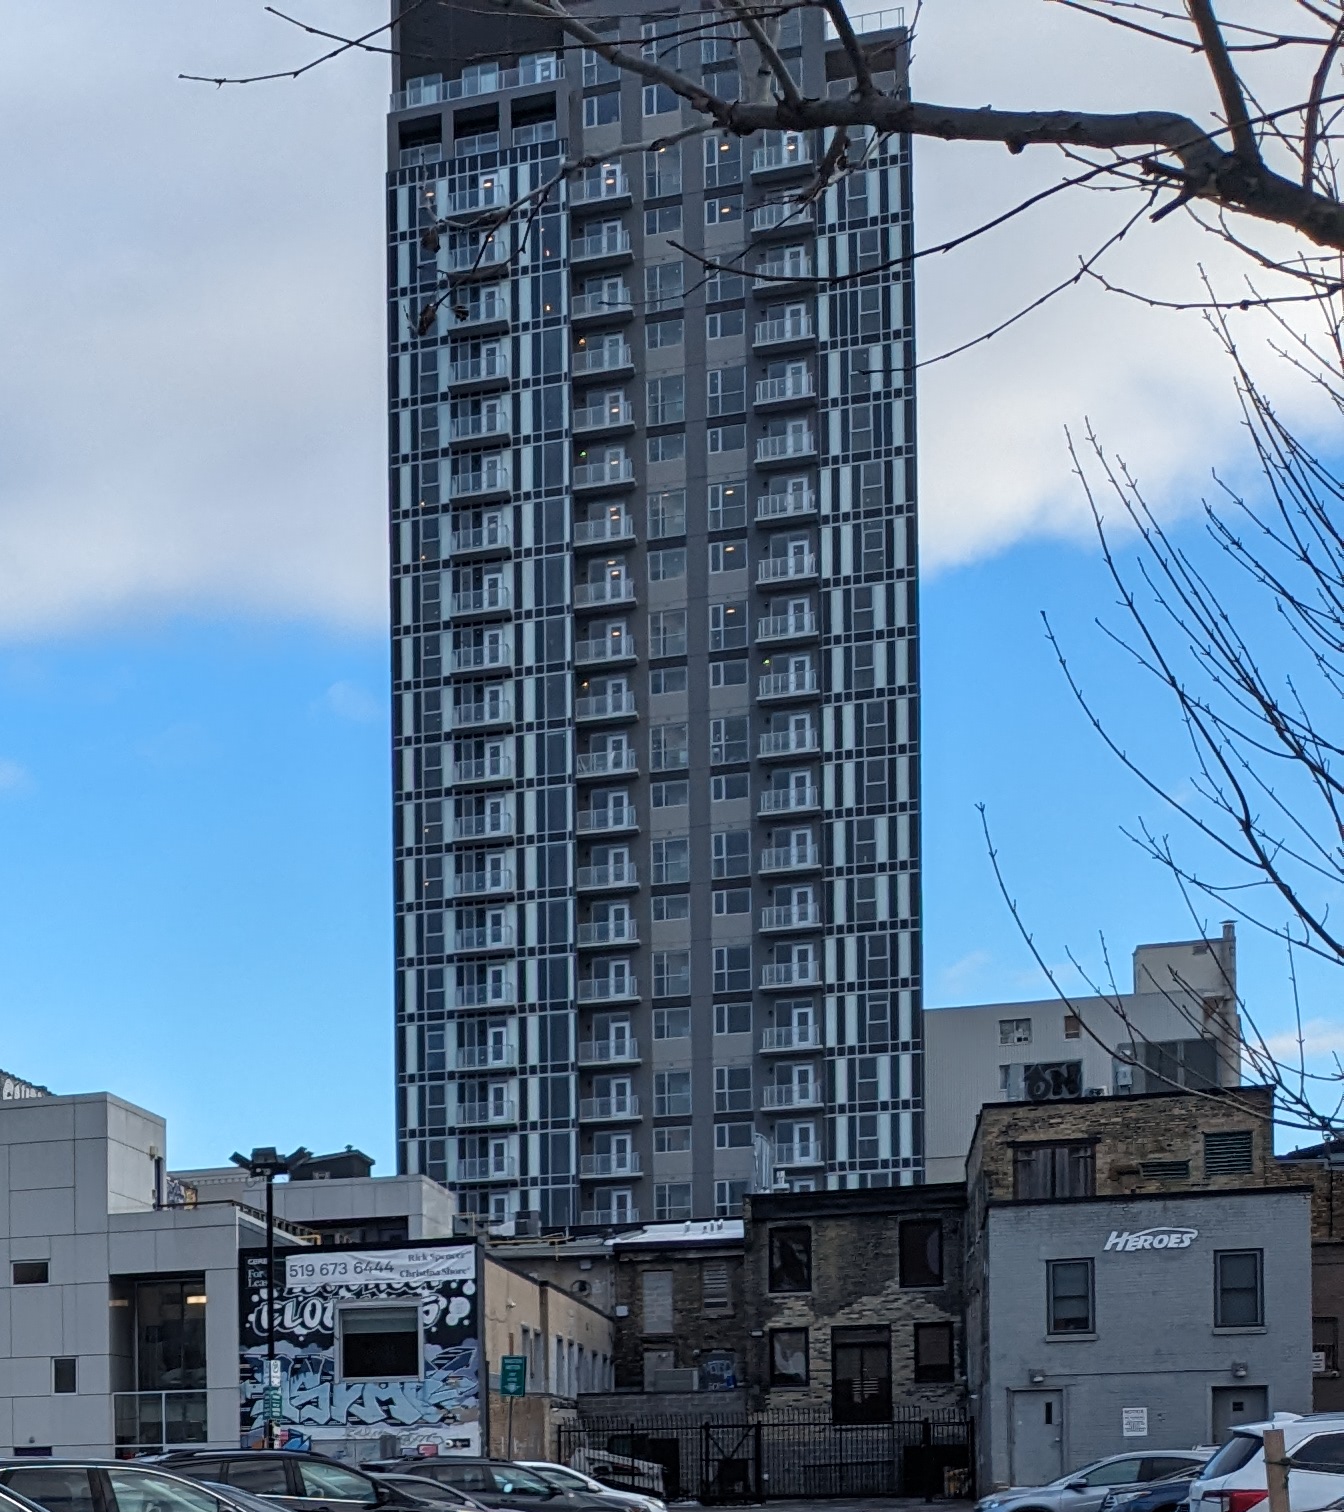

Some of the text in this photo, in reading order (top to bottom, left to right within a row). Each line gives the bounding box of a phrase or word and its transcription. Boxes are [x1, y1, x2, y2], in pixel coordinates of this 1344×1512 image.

[1103, 1227, 1198, 1251] HEROES
[247, 1270, 264, 1279] For
[289, 1260, 395, 1278] 519 673 6444
